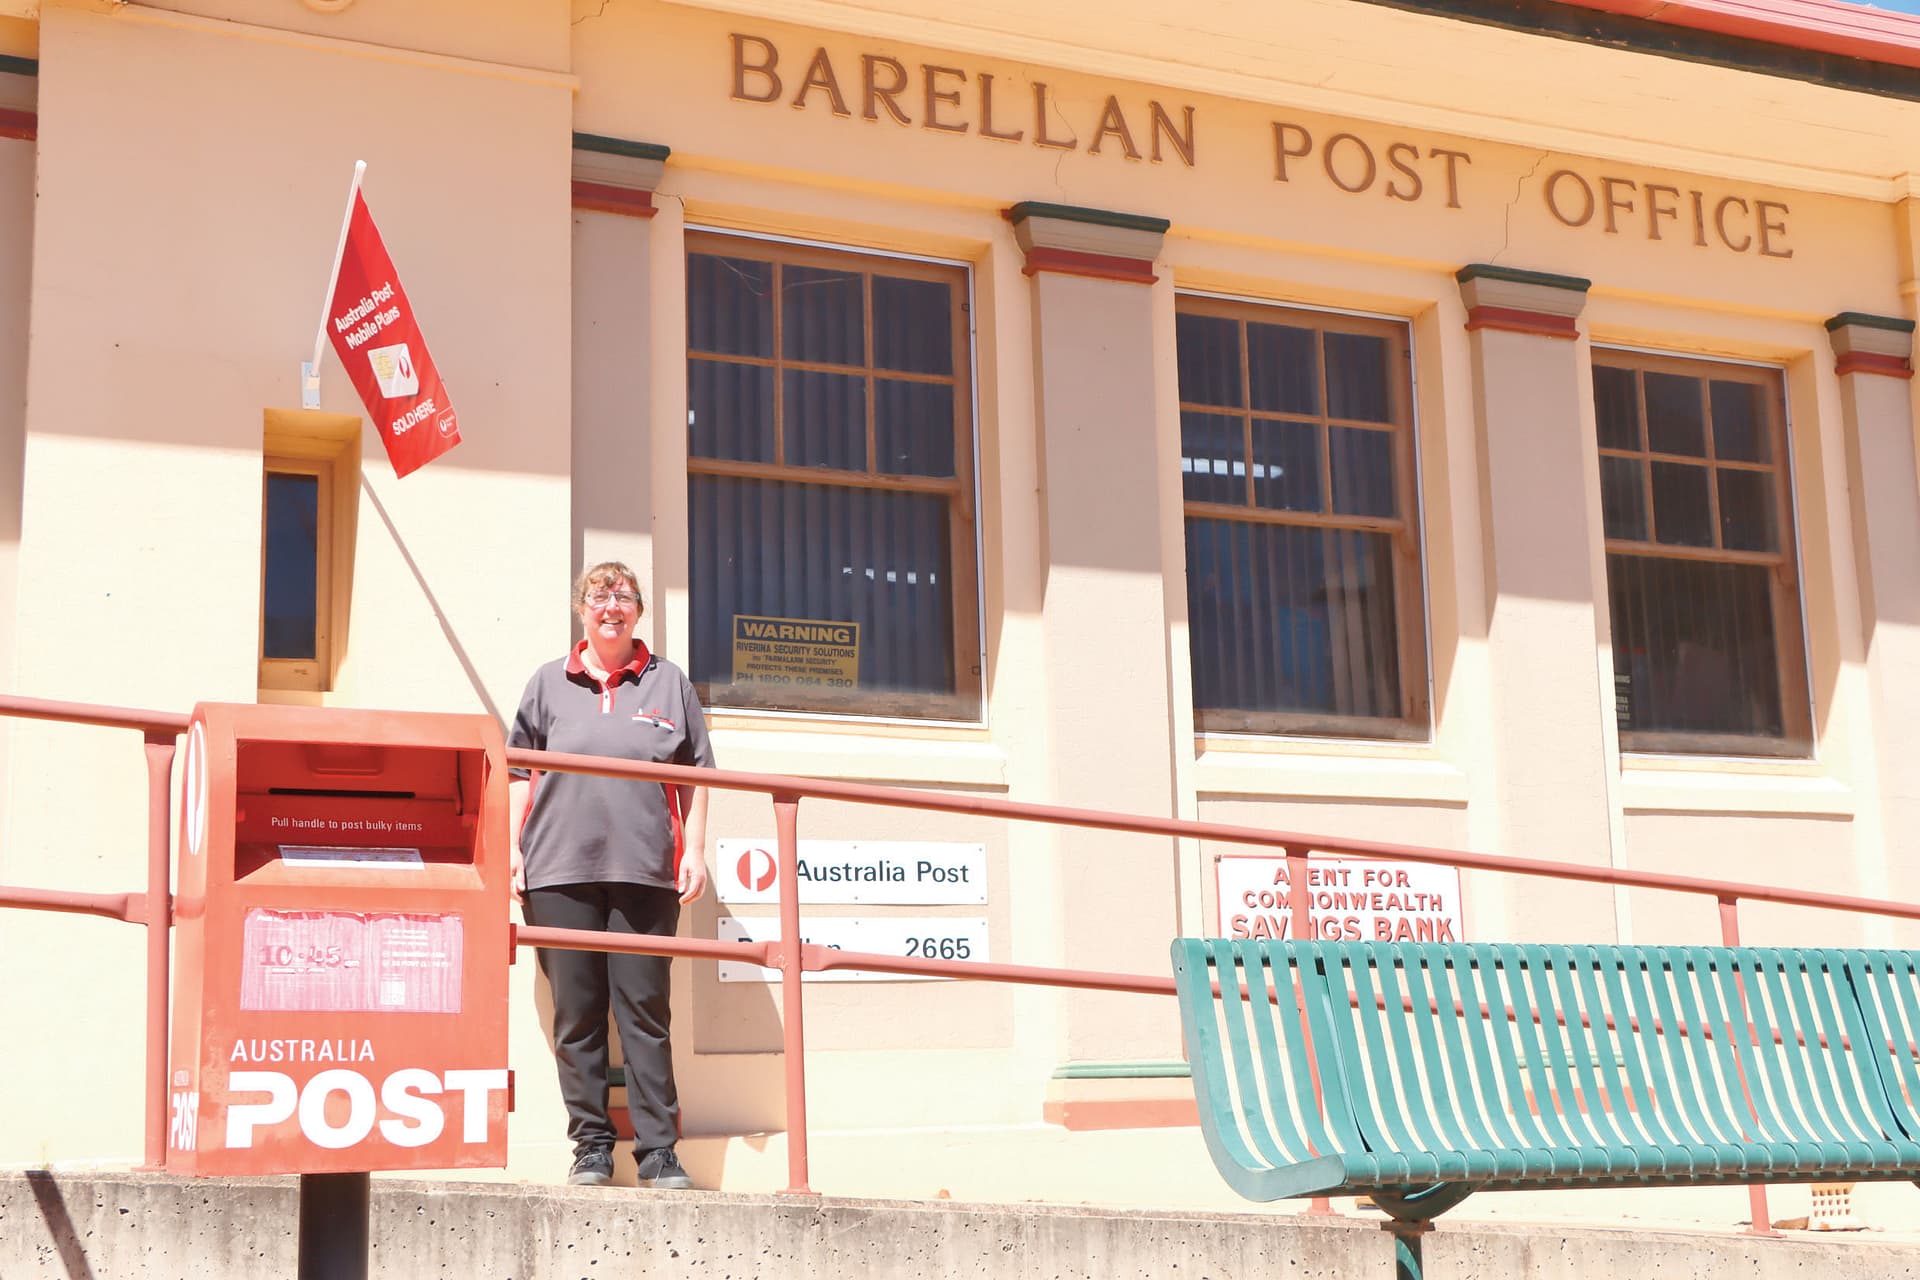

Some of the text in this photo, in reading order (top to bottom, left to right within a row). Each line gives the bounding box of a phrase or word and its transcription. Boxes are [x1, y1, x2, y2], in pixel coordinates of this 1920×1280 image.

[729, 32, 1794, 259] BARELLAN POST OFFICE
[335, 281, 394, 333] Australia Post
[345, 306, 401, 350] Mobile Plans
[392, 411, 415, 436] SOLD
[412, 398, 436, 424] HERE
[743, 622, 850, 643] WARNING
[736, 642, 856, 659] RIVERINA SECURITY SOLUTIONS
[736, 672, 754, 681] PH
[827, 678, 853, 689] 380
[271, 816, 423, 832] Pull handle to post bulky items
[796, 859, 969, 883] Australia Post
[1273, 868, 1411, 888] AENT FOR
[1242, 890, 1443, 912] COMONWEALTH
[1374, 916, 1456, 943] BANK
[905, 937, 972, 960] 2665
[231, 1039, 376, 1062] AUSTRALIA
[225, 1068, 509, 1149] POST
[170, 1092, 200, 1152] POST
